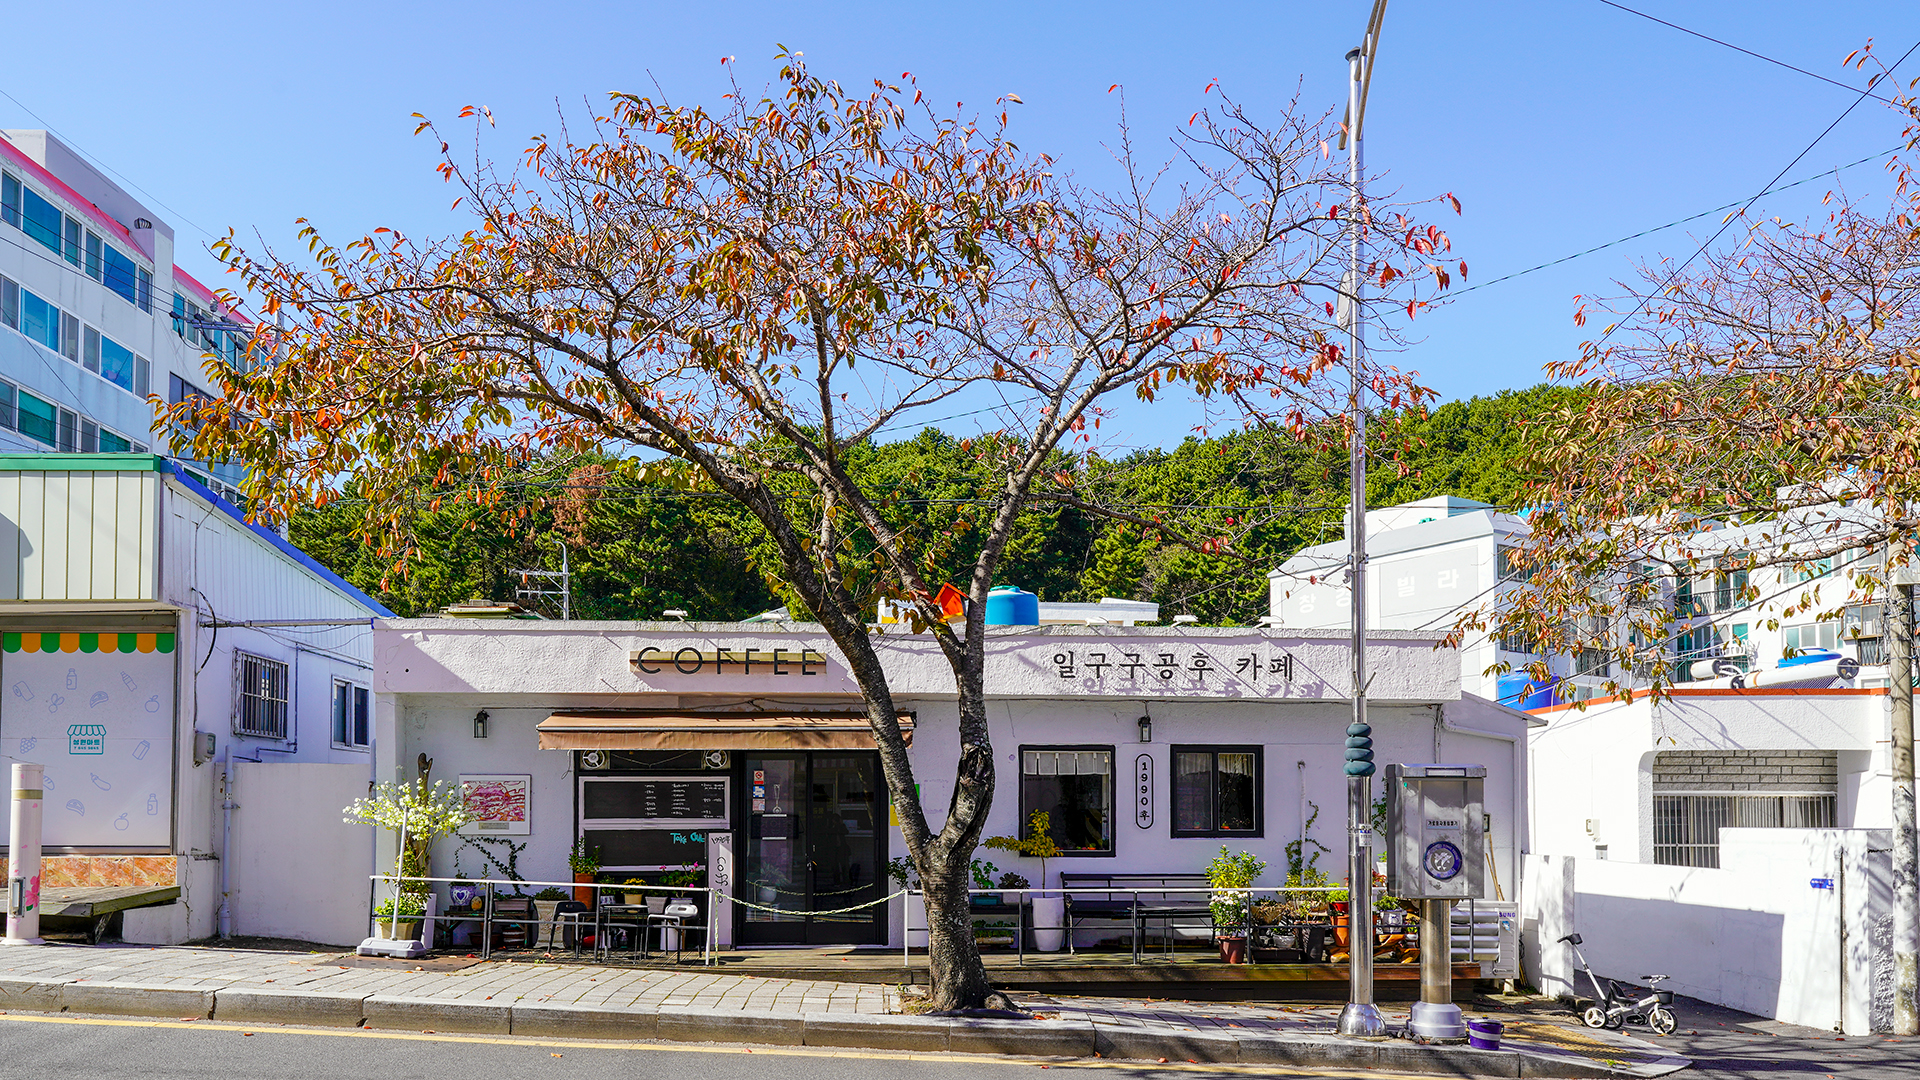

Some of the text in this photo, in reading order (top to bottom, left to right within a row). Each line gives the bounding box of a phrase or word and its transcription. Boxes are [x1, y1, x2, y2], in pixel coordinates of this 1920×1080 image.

[1397, 568, 1459, 598] 빌라
[637, 646, 817, 676] COFFEE
[1053, 650, 1294, 682] 일구구공후 카페
[1139, 761, 1150, 821] 1990후
[670, 832, 687, 845] Take
